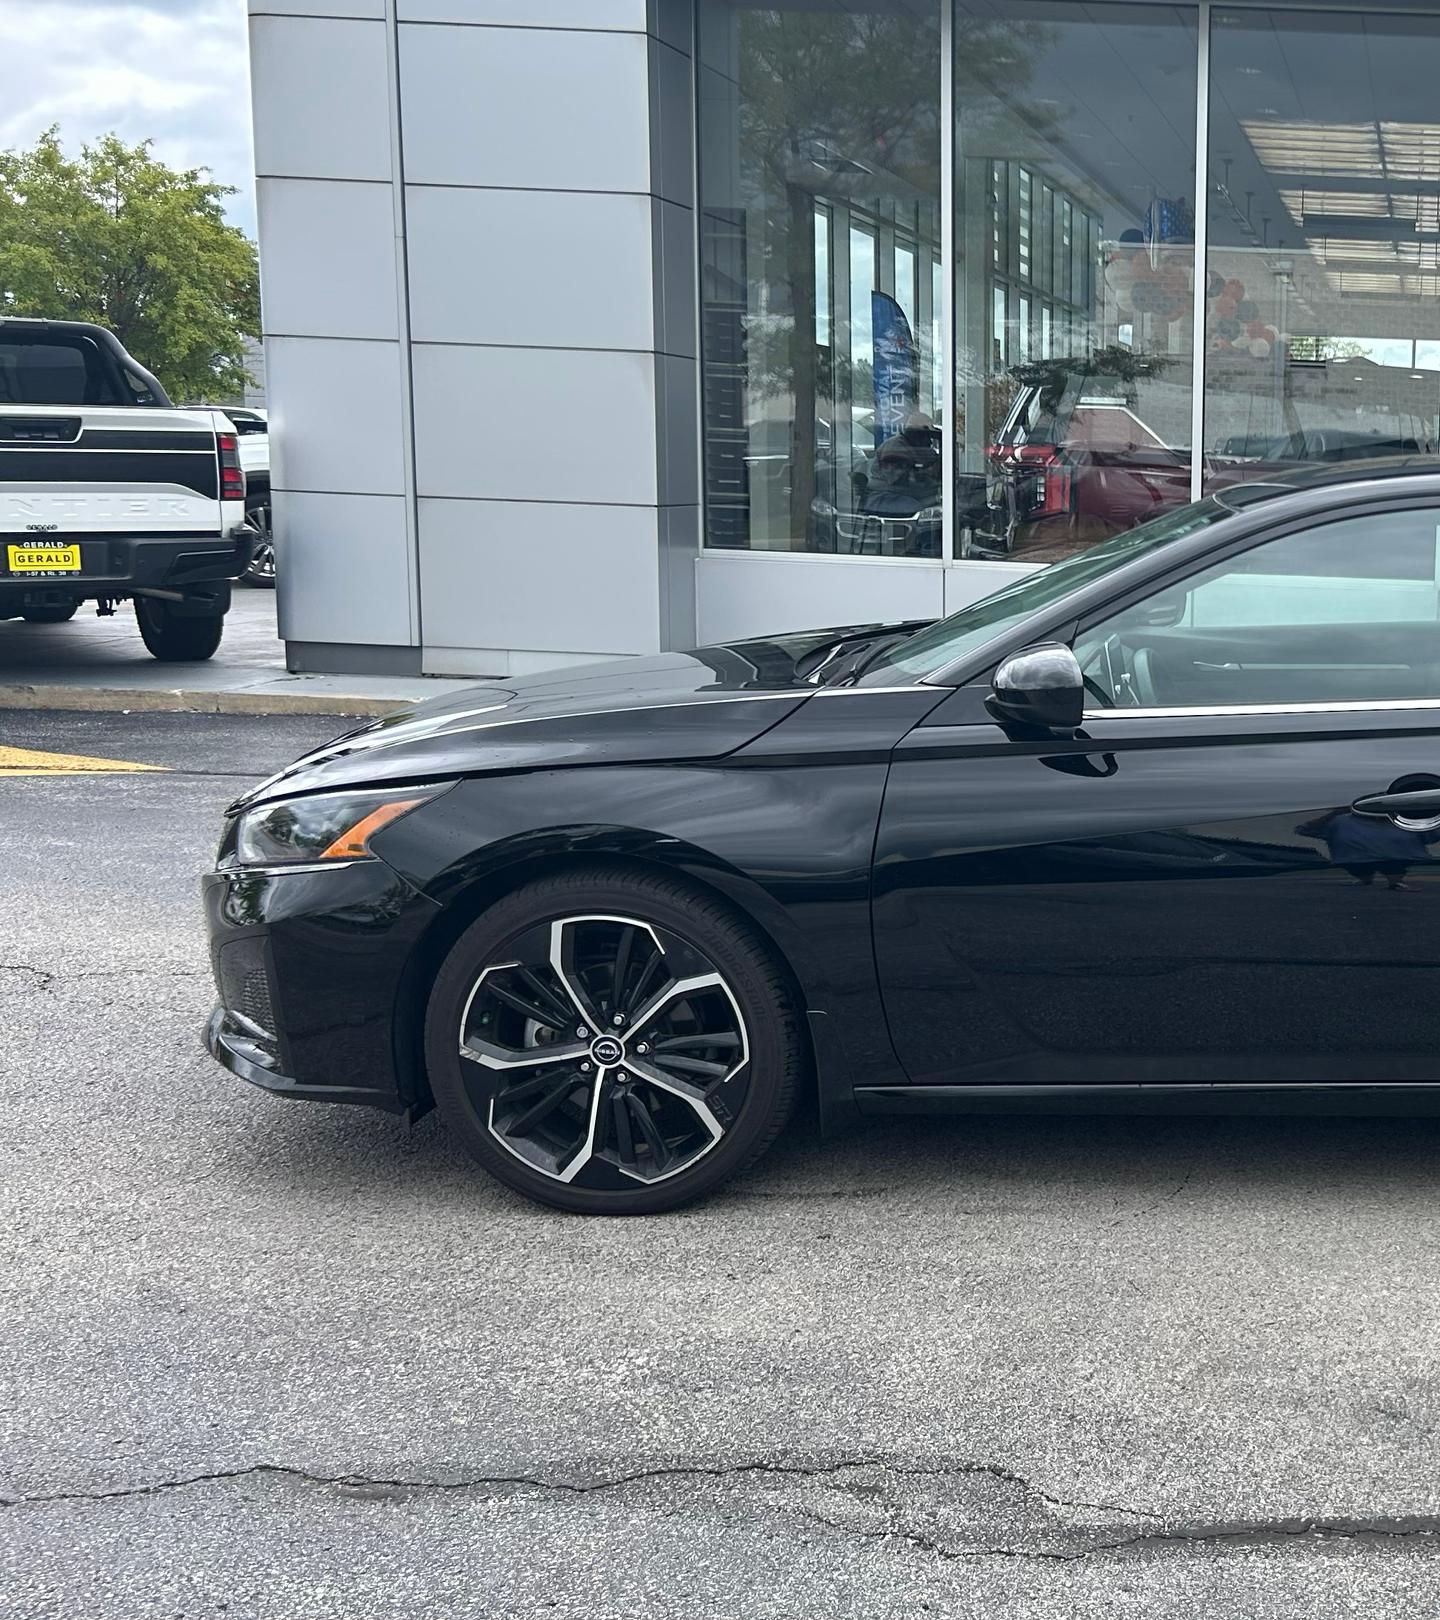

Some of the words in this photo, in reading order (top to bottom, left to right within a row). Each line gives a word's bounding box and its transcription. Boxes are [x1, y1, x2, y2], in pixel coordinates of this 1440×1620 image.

[890, 366, 905, 434] EVENT
[23, 541, 64, 549] GERALD
[17, 554, 71, 563] GERALD
